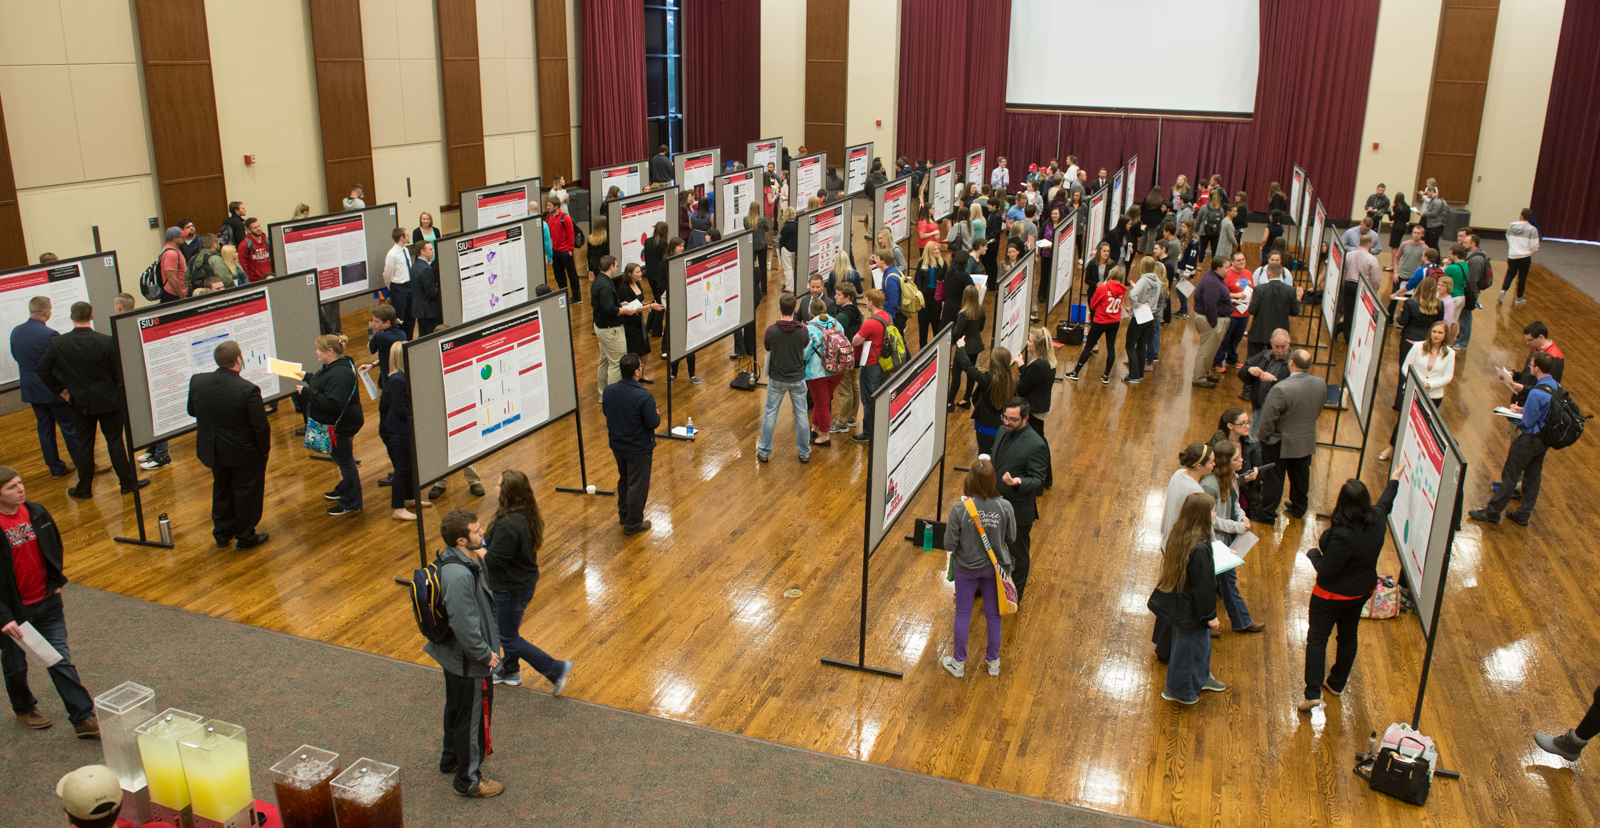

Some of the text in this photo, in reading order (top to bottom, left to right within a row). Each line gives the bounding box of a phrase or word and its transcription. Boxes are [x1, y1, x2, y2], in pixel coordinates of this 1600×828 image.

[458, 240, 473, 251] SIUe
[307, 275, 314, 284] 24
[1105, 296, 1122, 314] 20
[141, 317, 160, 329] SIUe
[443, 341, 454, 351] SIUe
